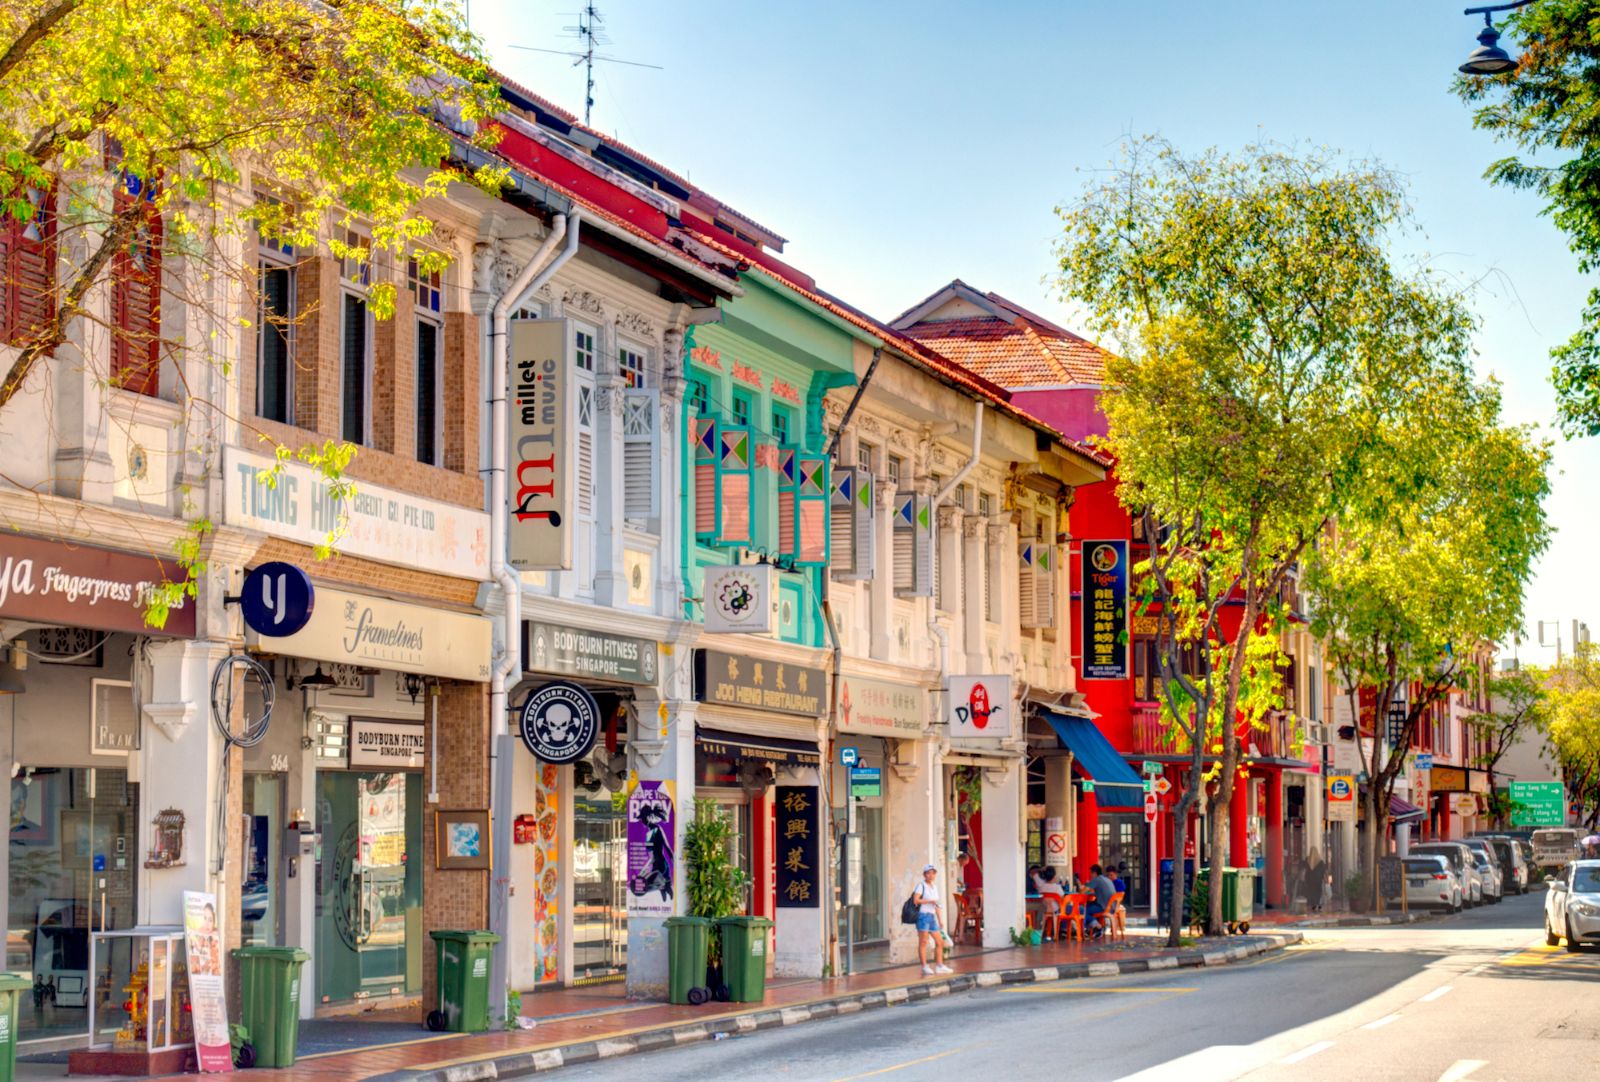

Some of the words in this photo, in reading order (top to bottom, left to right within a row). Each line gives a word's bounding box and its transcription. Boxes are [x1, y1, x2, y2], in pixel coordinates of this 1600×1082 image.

[516, 360, 536, 425] millet
[536, 359, 556, 425] music
[237, 463, 298, 526] TIONG
[353, 491, 383, 518] CREDIT
[403, 503, 420, 528] PTE
[421, 510, 435, 531] LTD
[40, 565, 132, 605] Fingerpress
[1091, 573, 1118, 587] Tiger
[554, 631, 603, 656] BODYBURN
[604, 638, 638, 660] FITNESS
[575, 656, 619, 675] SINGAPORE
[527, 689, 563, 721] BODYBURN
[564, 691, 590, 721] FITNESS
[715, 683, 735, 701] JOO
[763, 690, 819, 713] RESTAURANT
[358, 731, 400, 747] BODYBURN
[401, 734, 424, 748] FITNE
[380, 746, 412, 758] SINGAPORE
[537, 743, 579, 757] SINGAPORE
[270, 754, 289, 771] 364
[1145, 803, 1156, 814] STOP
[783, 791, 811, 902] 裕興菜館
